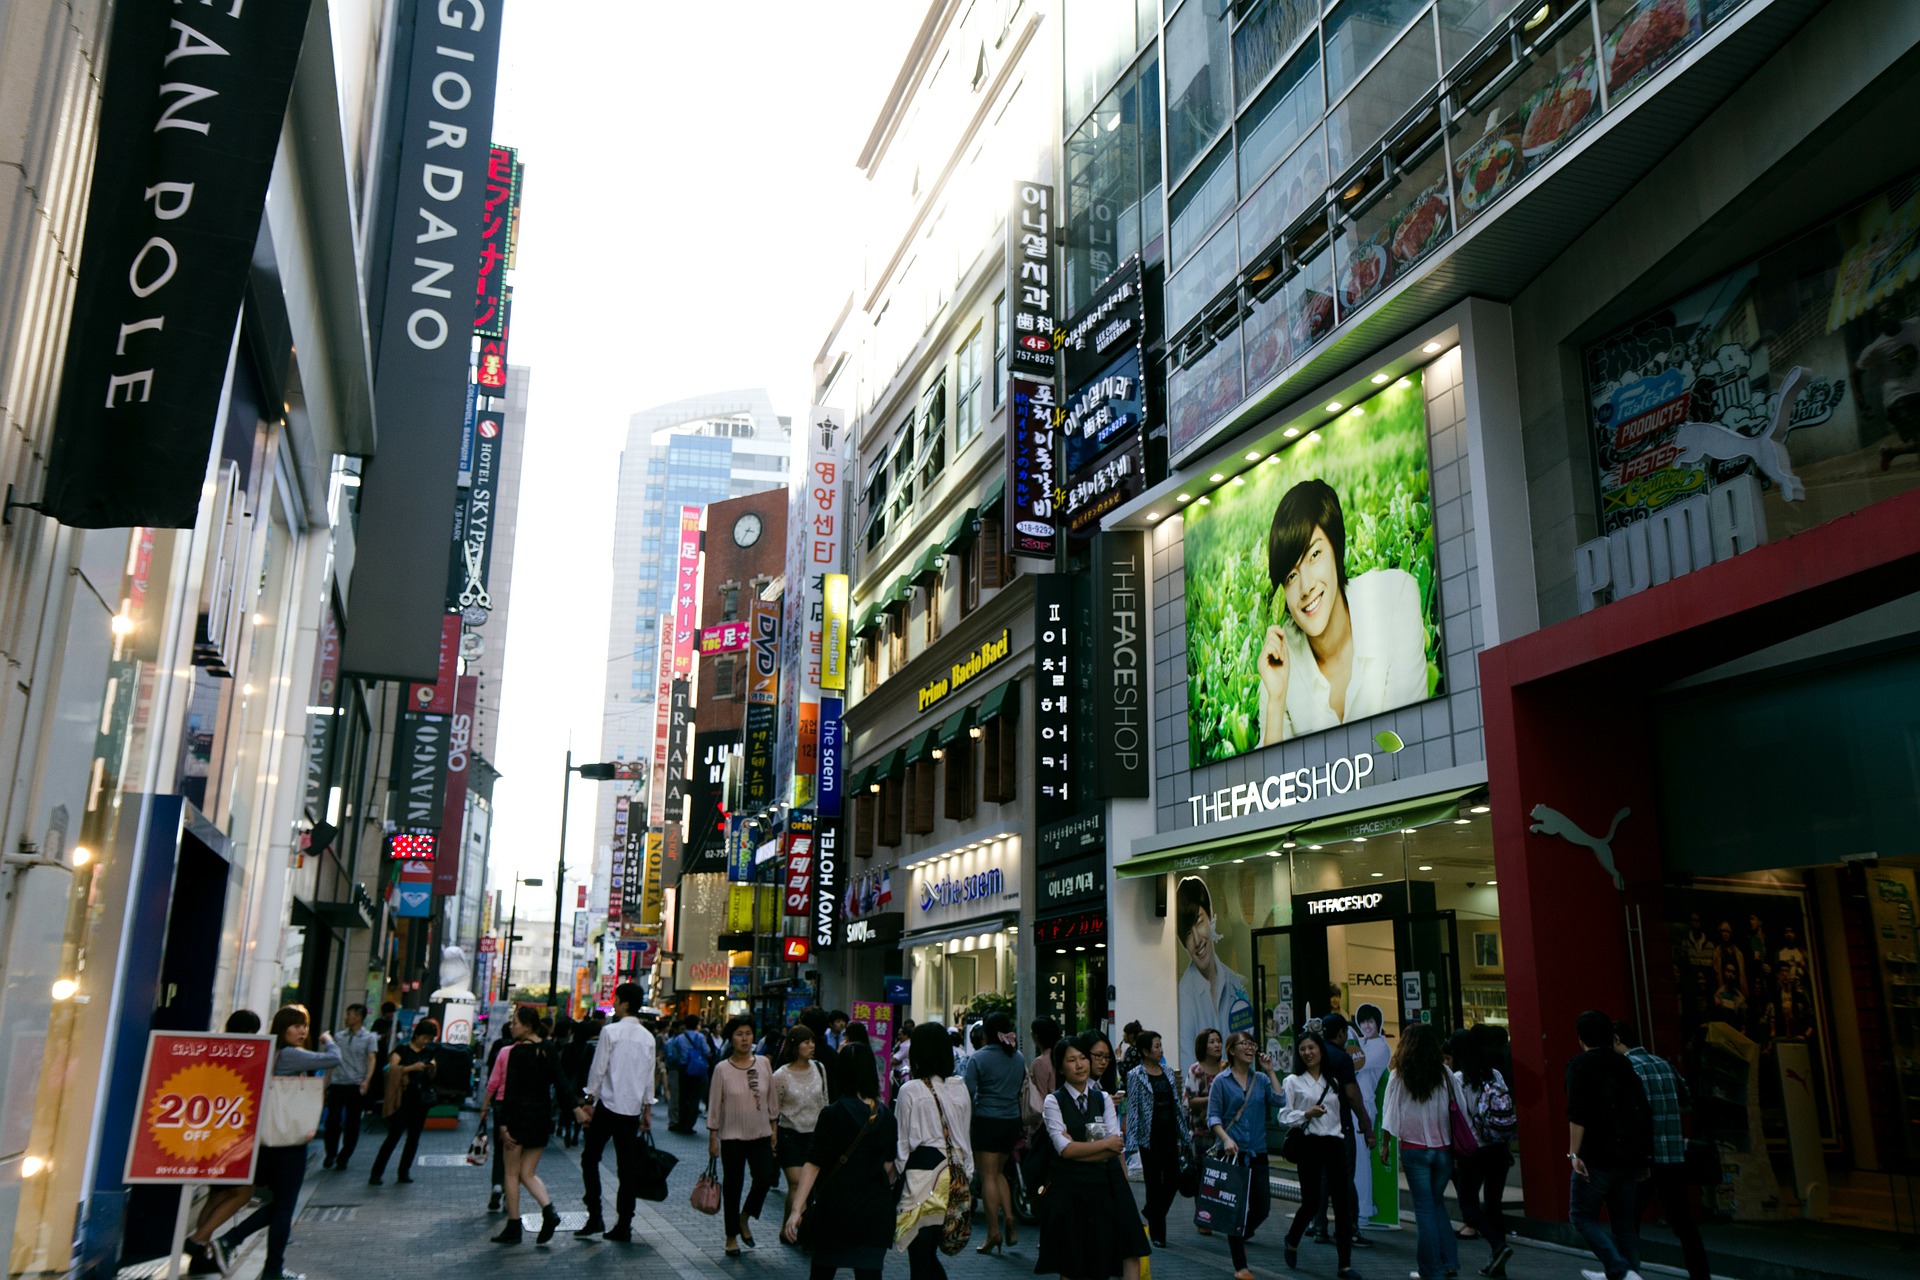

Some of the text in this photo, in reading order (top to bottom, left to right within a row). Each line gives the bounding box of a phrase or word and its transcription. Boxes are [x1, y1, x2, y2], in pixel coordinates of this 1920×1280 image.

[406, 0, 486, 350] GIORDANO
[105, 0, 243, 410] AN POLE
[1027, 338, 1045, 349] 4F
[1054, 327, 1067, 351] 5F
[1016, 350, 1055, 365] 757-8275
[1053, 407, 1066, 428] 4F
[1097, 414, 1128, 442] 757-8275
[1621, 401, 1684, 444] PRODUCTS
[478, 443, 492, 485] HOTEL
[813, 462, 836, 563] 영양센타
[1053, 488, 1066, 509] 3F
[1019, 522, 1053, 535] 318-9292
[1575, 474, 1768, 616] PUMA
[676, 541, 698, 644] 足マッサージ
[722, 628, 737, 647] 足
[754, 613, 778, 676] DVD
[675, 656, 690, 667] 5F
[1112, 555, 1138, 770] THEFACESHOP
[918, 679, 949, 712] Primo
[447, 713, 471, 773] SPAO
[668, 693, 687, 800] TRIANA
[821, 720, 837, 792] the saem
[407, 725, 440, 821] MANGO
[1188, 753, 1374, 827] THEFACESHOP
[790, 822, 813, 831] OPEN
[802, 815, 812, 823] 24
[787, 838, 812, 911] 롯데리아
[817, 827, 836, 947] SAVOY HOTEL
[939, 867, 1004, 907] the saem
[1307, 893, 1383, 915] THEFACESHOP
[847, 920, 868, 943] SAVOY
[171, 1042, 256, 1058] GAP DAYS
[154, 1093, 246, 1129] 20%
[183, 1130, 211, 1141] OFF
[1203, 1176, 1216, 1187] THE
[1205, 1167, 1228, 1181] THIS IS
